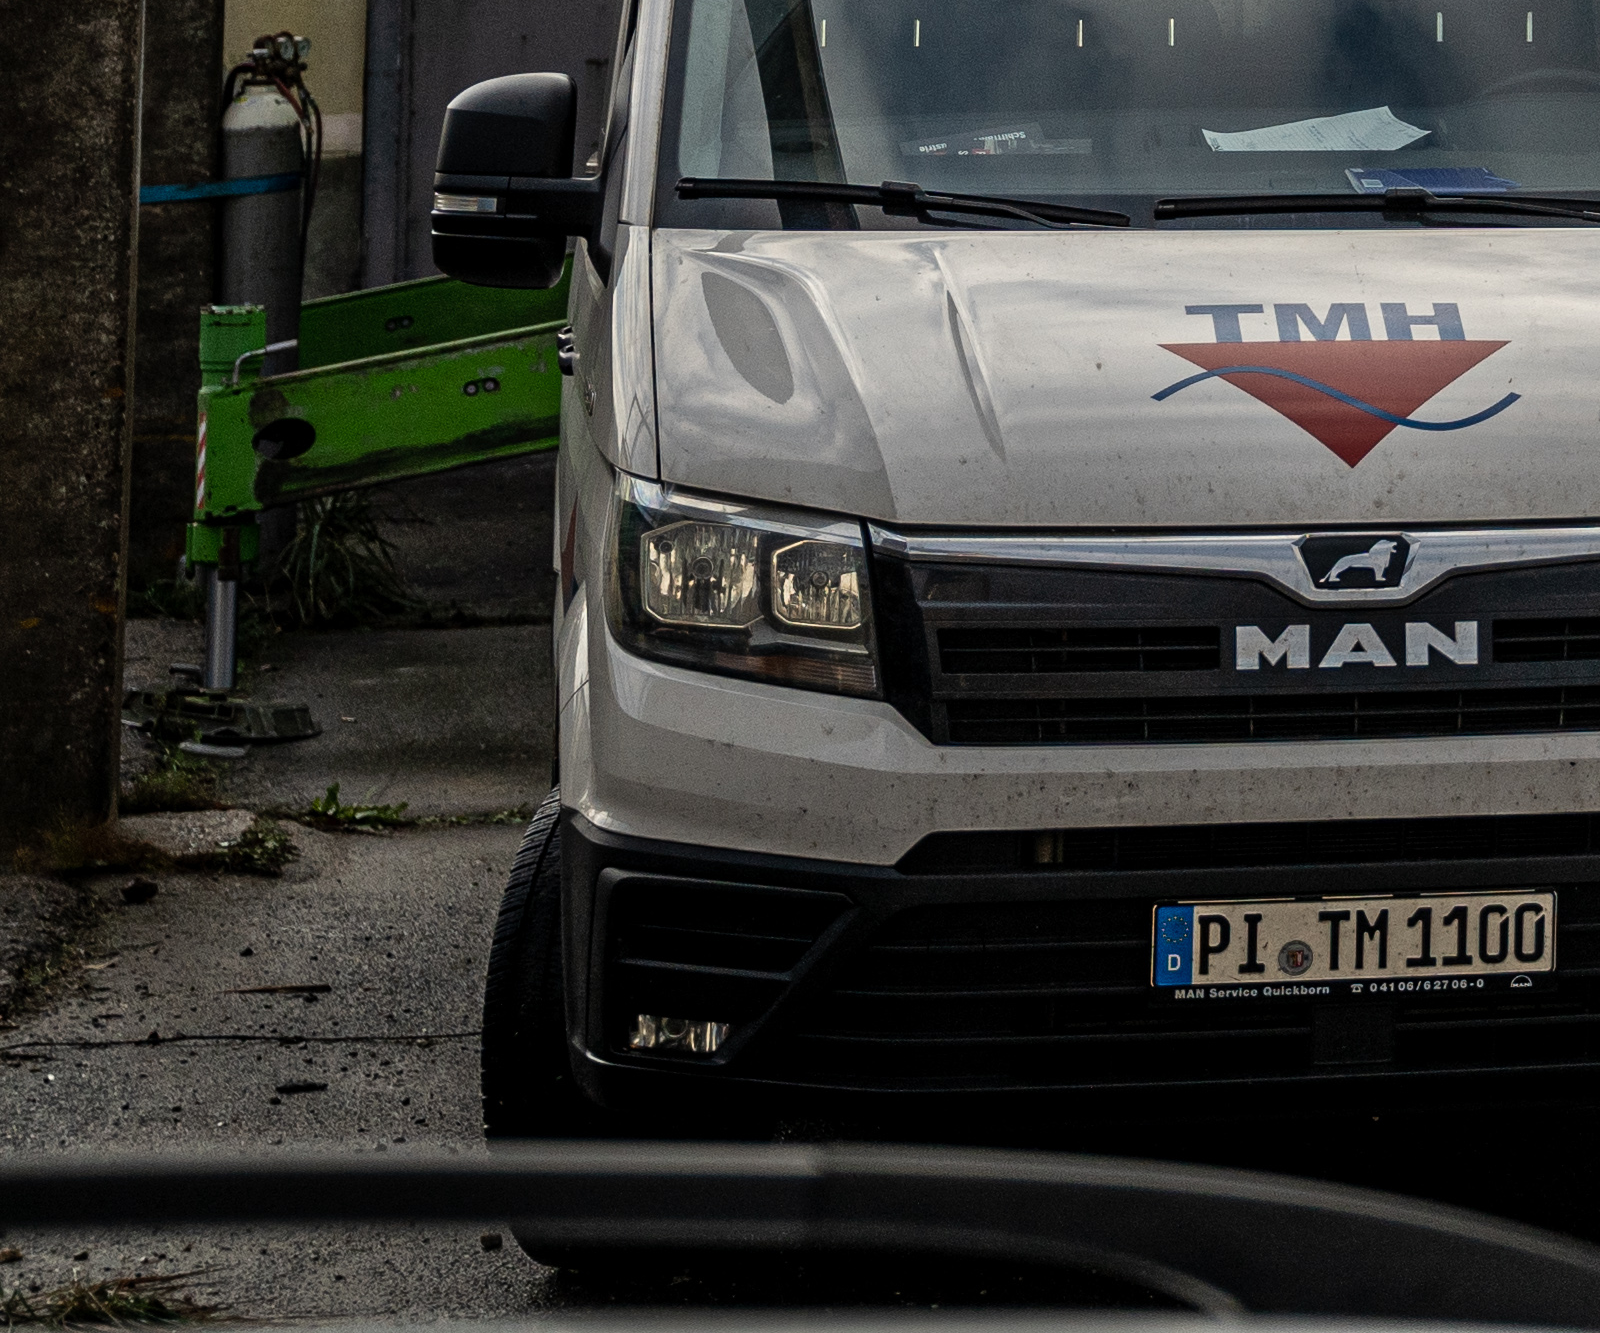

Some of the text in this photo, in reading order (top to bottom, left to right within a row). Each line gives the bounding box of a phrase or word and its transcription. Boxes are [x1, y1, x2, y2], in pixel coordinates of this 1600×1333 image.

[1185, 302, 1467, 344] TMH
[1235, 620, 1479, 671] MAN
[1198, 902, 1546, 975] PI TM 1100
[1167, 953, 1182, 972] D
[1174, 988, 1205, 1000] MAN
[1209, 987, 1258, 998] Service
[1262, 985, 1330, 997] Quickborn
